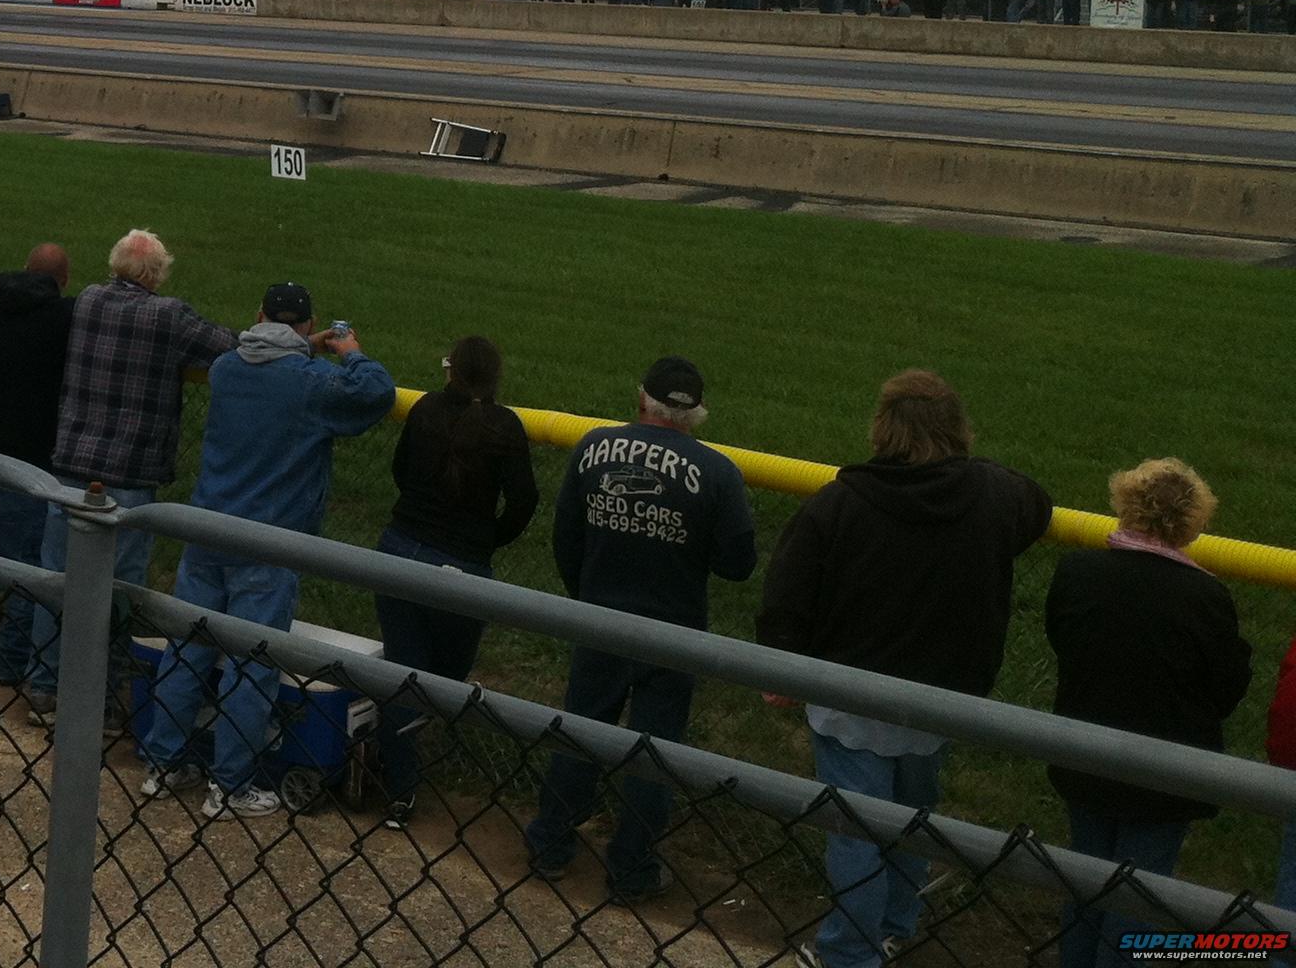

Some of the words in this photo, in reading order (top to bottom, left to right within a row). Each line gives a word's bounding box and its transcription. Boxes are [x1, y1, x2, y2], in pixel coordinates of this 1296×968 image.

[274, 147, 303, 176] 150
[578, 438, 702, 494] HARPER'S
[586, 493, 628, 514] USED
[634, 500, 684, 527] CARS
[586, 507, 688, 544] 815-695-9422
